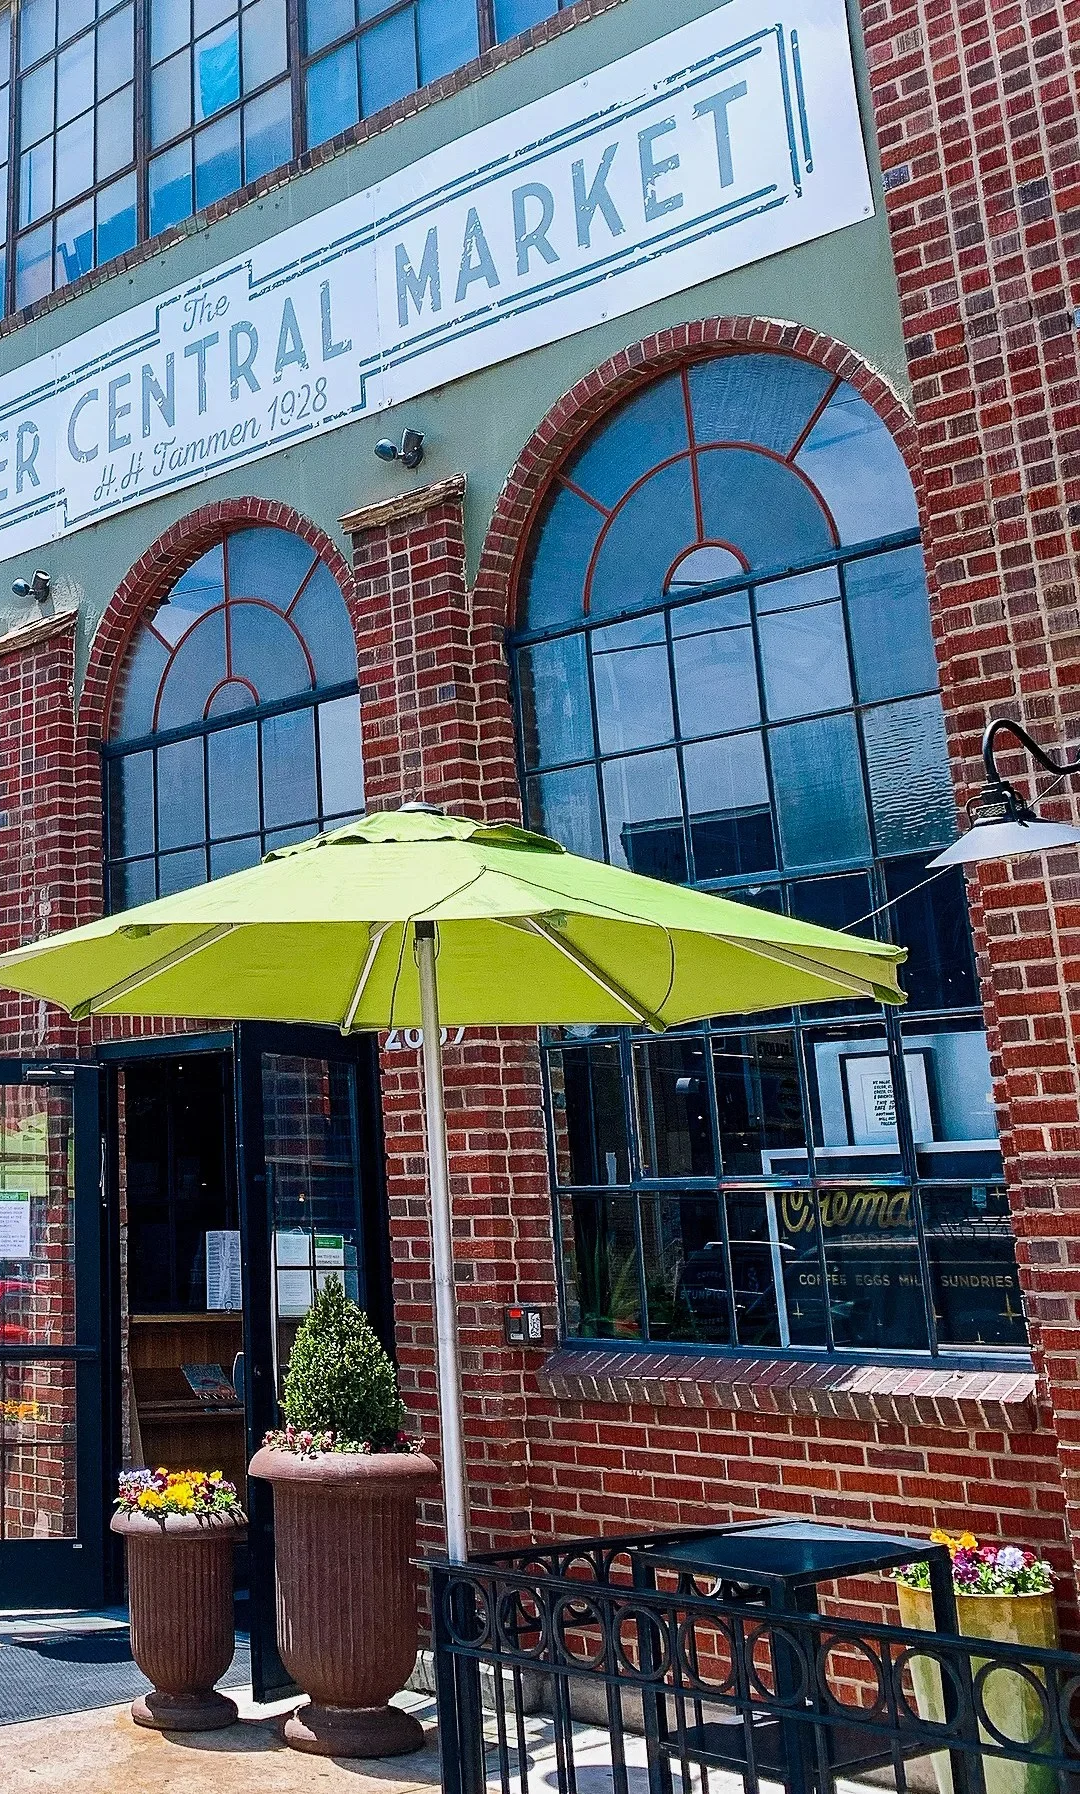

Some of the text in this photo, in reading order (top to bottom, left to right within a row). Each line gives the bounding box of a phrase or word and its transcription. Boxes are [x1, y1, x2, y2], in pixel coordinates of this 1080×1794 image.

[67, 279, 352, 463] CENTRAL
[395, 80, 747, 327] MARKET
[183, 293, 229, 332] The
[153, 416, 261, 477] Tammen
[267, 376, 328, 431] 1928
[855, 1274, 890, 1287] EGGS
[898, 1274, 923, 1287] MIL
[942, 1275, 1014, 1288] SUNDRIES
